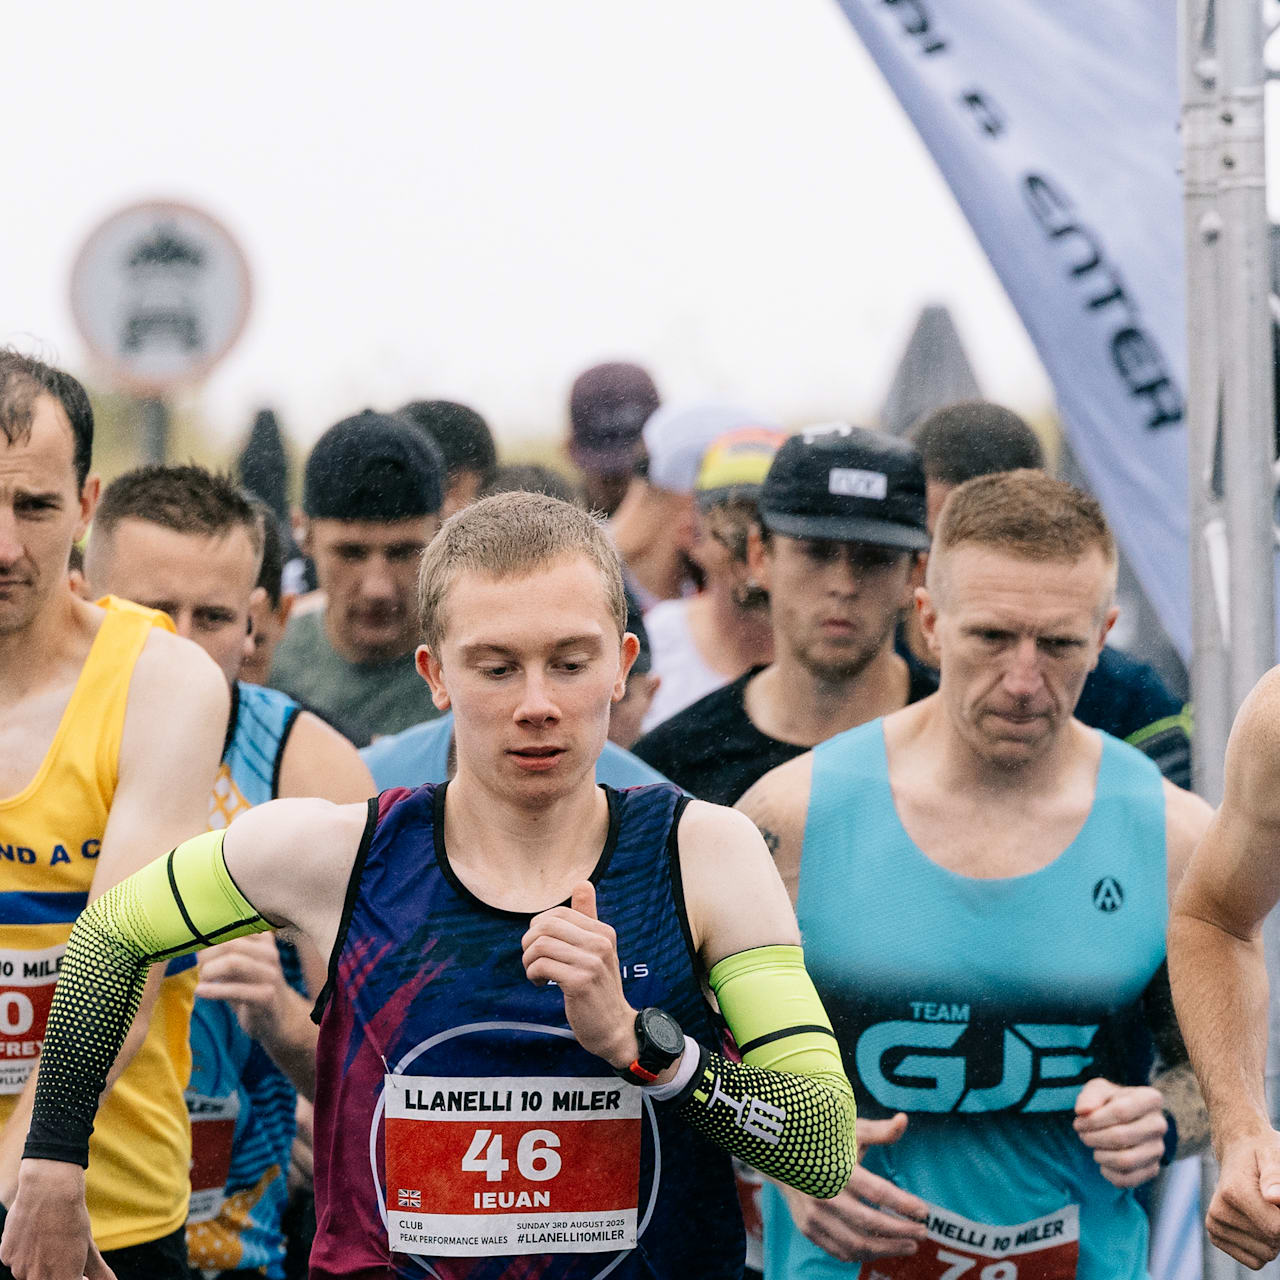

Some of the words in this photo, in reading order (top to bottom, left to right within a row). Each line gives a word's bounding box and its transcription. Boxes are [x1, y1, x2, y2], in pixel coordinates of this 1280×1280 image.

[49, 845, 71, 866] A
[81, 838, 101, 860] C
[23, 955, 65, 978] MILE
[909, 1001, 970, 1022] TEAM
[404, 1089, 513, 1112] LLANELLI
[521, 1090, 543, 1112] 10
[552, 1090, 622, 1112] MILER
[461, 1129, 562, 1182] 46
[473, 1191, 551, 1209] IEUAN
[399, 1220, 423, 1230] CLUB
[516, 1221, 551, 1230] SUNDAY
[552, 1221, 568, 1229] 3RD
[570, 1220, 605, 1229] AUGUST
[606, 1218, 625, 1228] 2025
[923, 1214, 987, 1248] ANELLI
[993, 1237, 1011, 1251] 10
[1015, 1219, 1064, 1246] MILER
[400, 1233, 418, 1244] PEAK
[419, 1235, 479, 1245] PERFORMANCE
[480, 1235, 508, 1245] WALES
[517, 1229, 625, 1245] #LLANELLI10MILER
